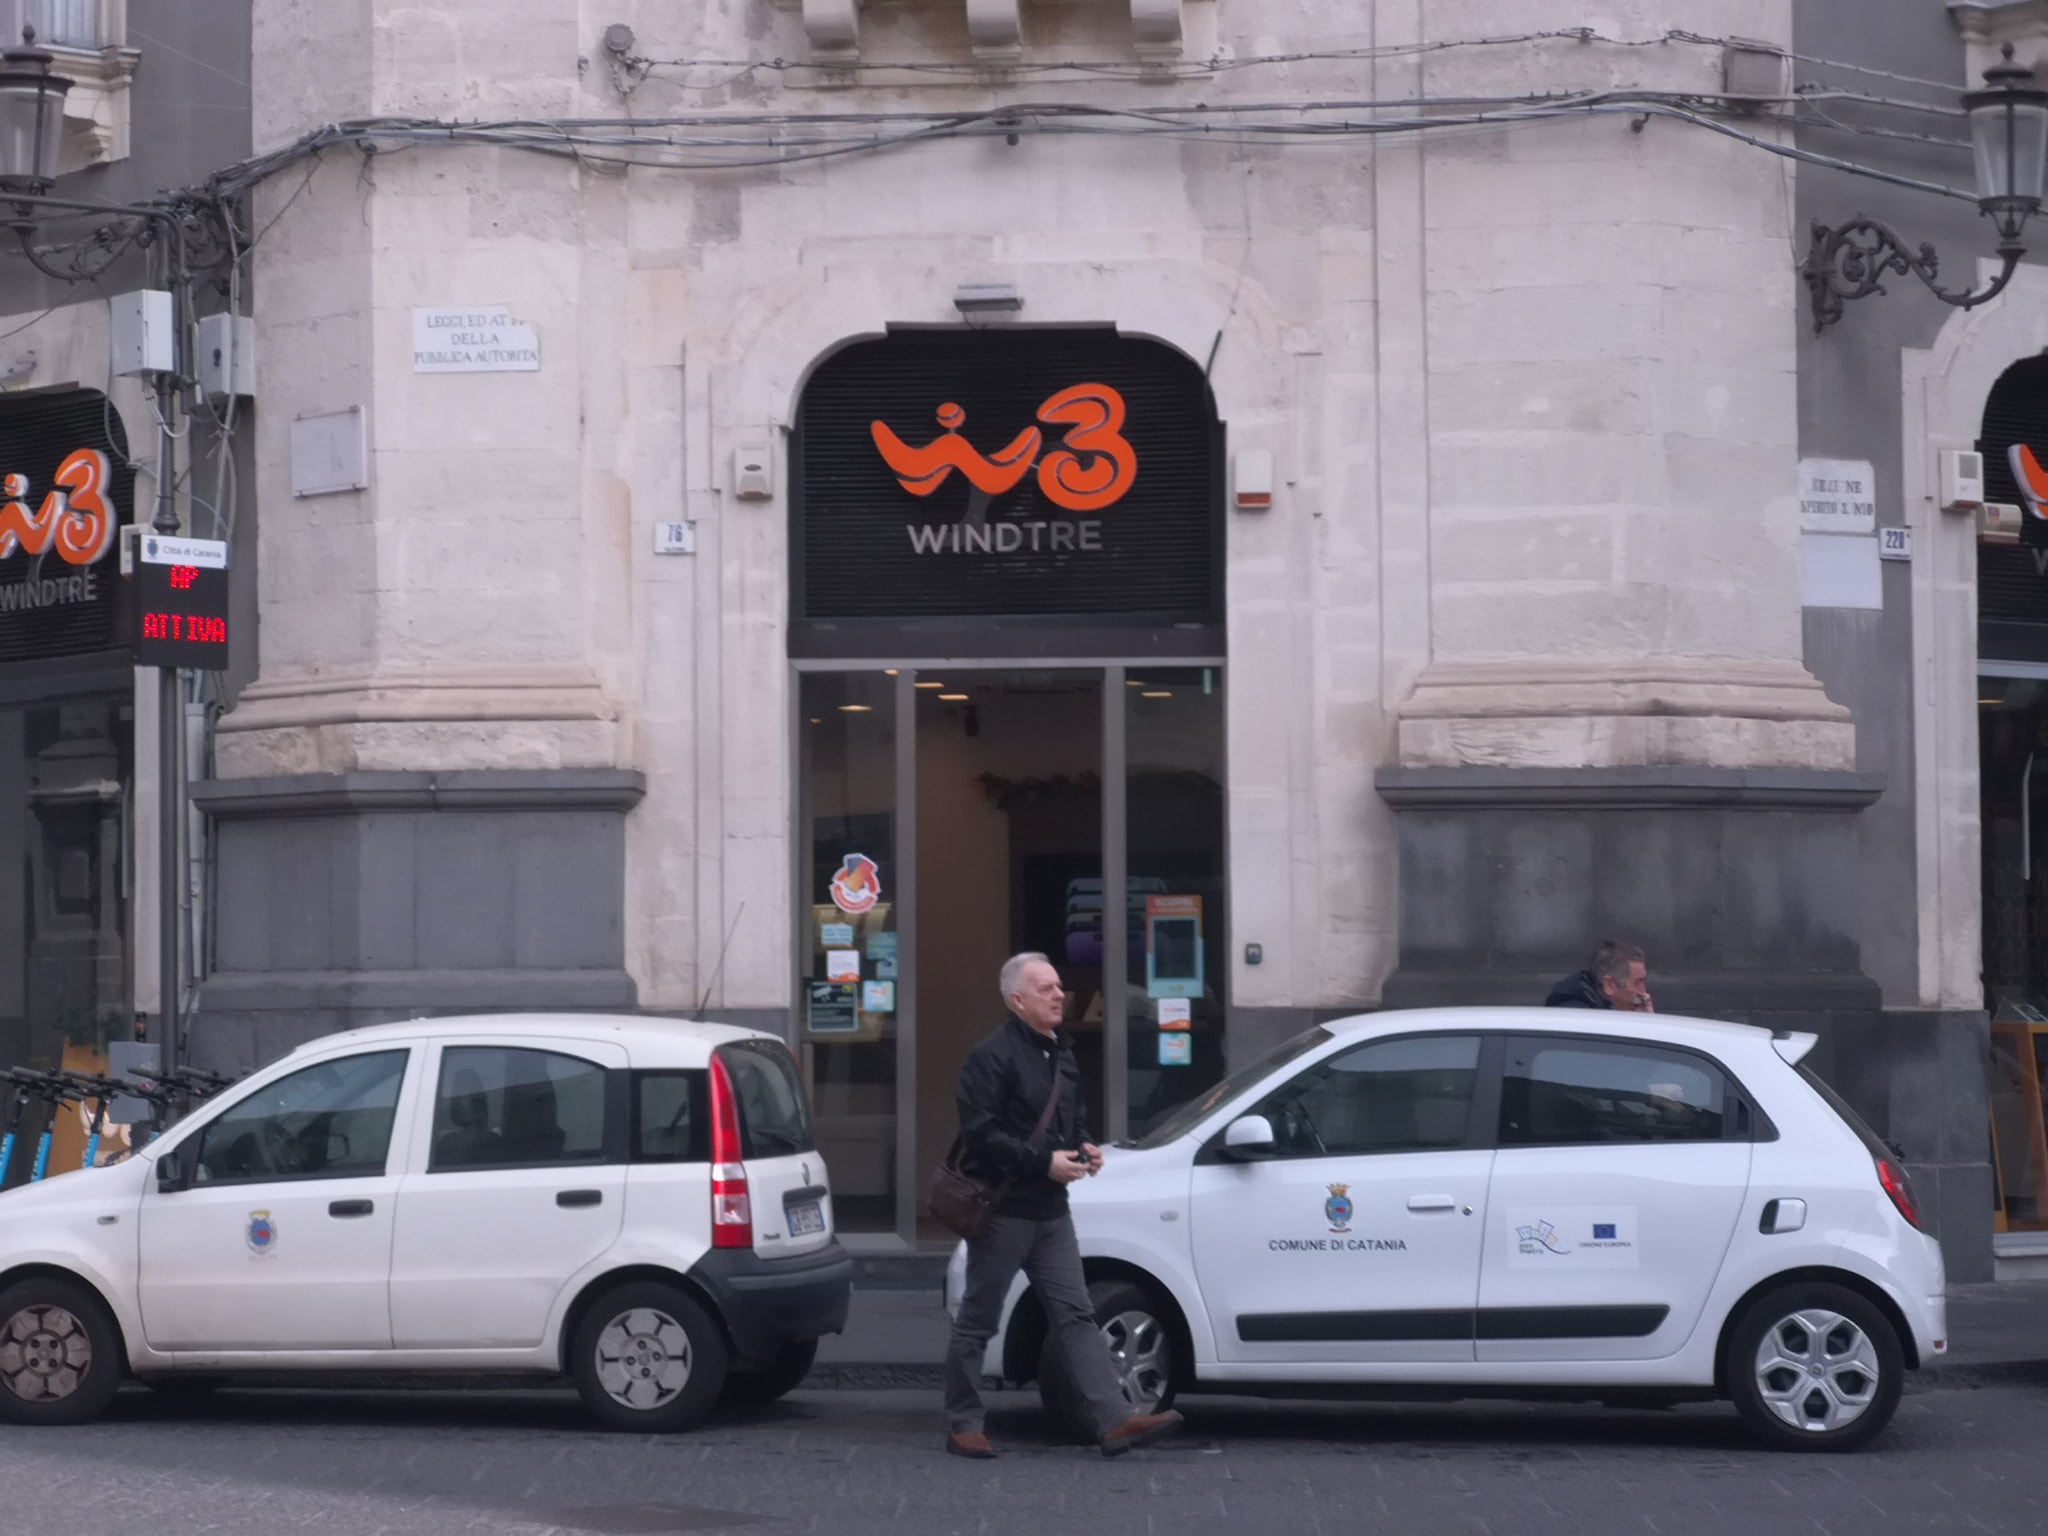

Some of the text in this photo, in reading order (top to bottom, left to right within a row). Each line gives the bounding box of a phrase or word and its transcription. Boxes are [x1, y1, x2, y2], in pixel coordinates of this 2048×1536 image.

[451, 332, 500, 345] DELLA
[414, 351, 472, 364] PUBBLICA
[667, 523, 683, 543] 76
[907, 520, 1103, 554] WINDTRE
[163, 545, 222, 559] Città di Catania
[169, 563, 199, 589] AP
[143, 612, 226, 643] ATTIVA
[1268, 1239, 1408, 1251] COMUNE DI CATANIA
